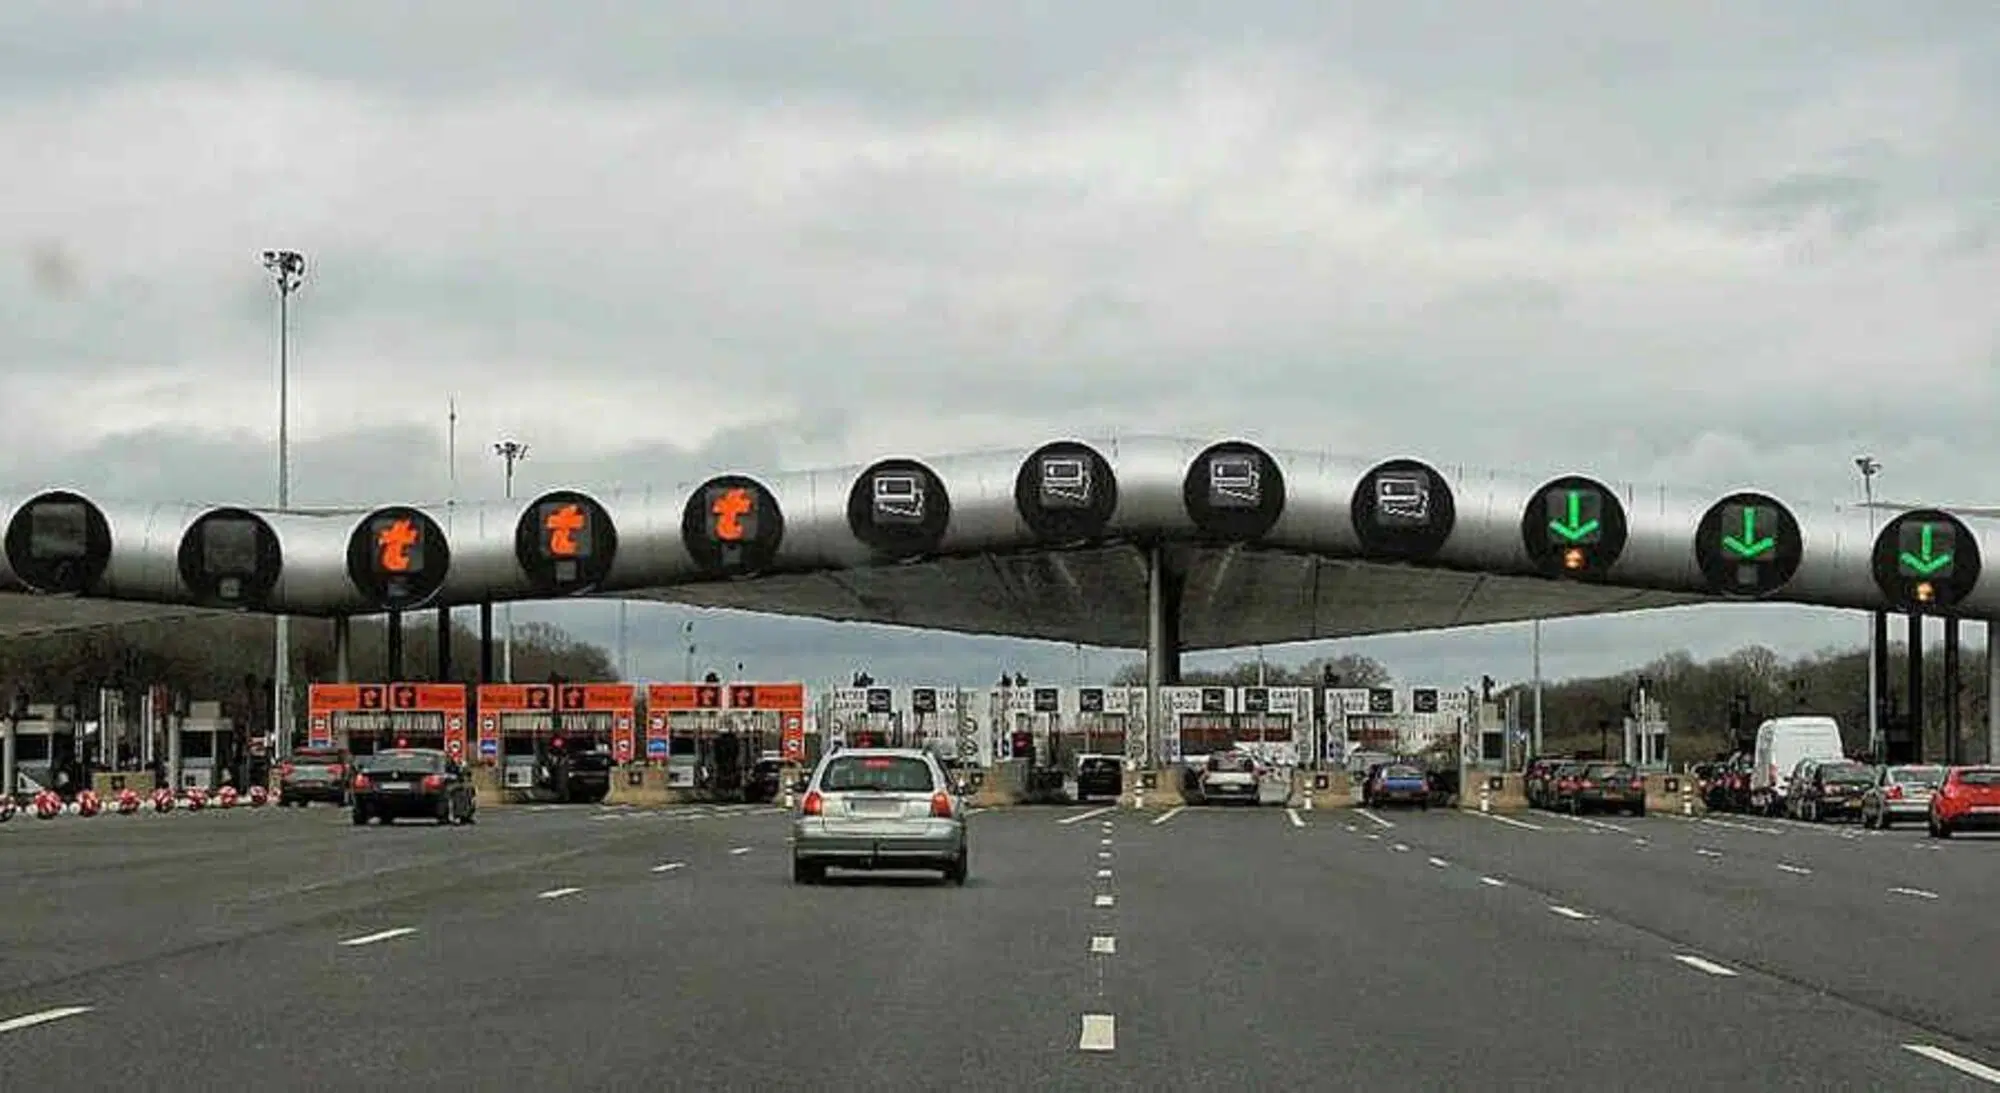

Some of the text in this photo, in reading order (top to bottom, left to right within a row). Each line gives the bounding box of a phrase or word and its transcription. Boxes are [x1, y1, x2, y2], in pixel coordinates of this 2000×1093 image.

[545, 504, 585, 556] t
[713, 488, 753, 541] t
[378, 519, 418, 571] t
